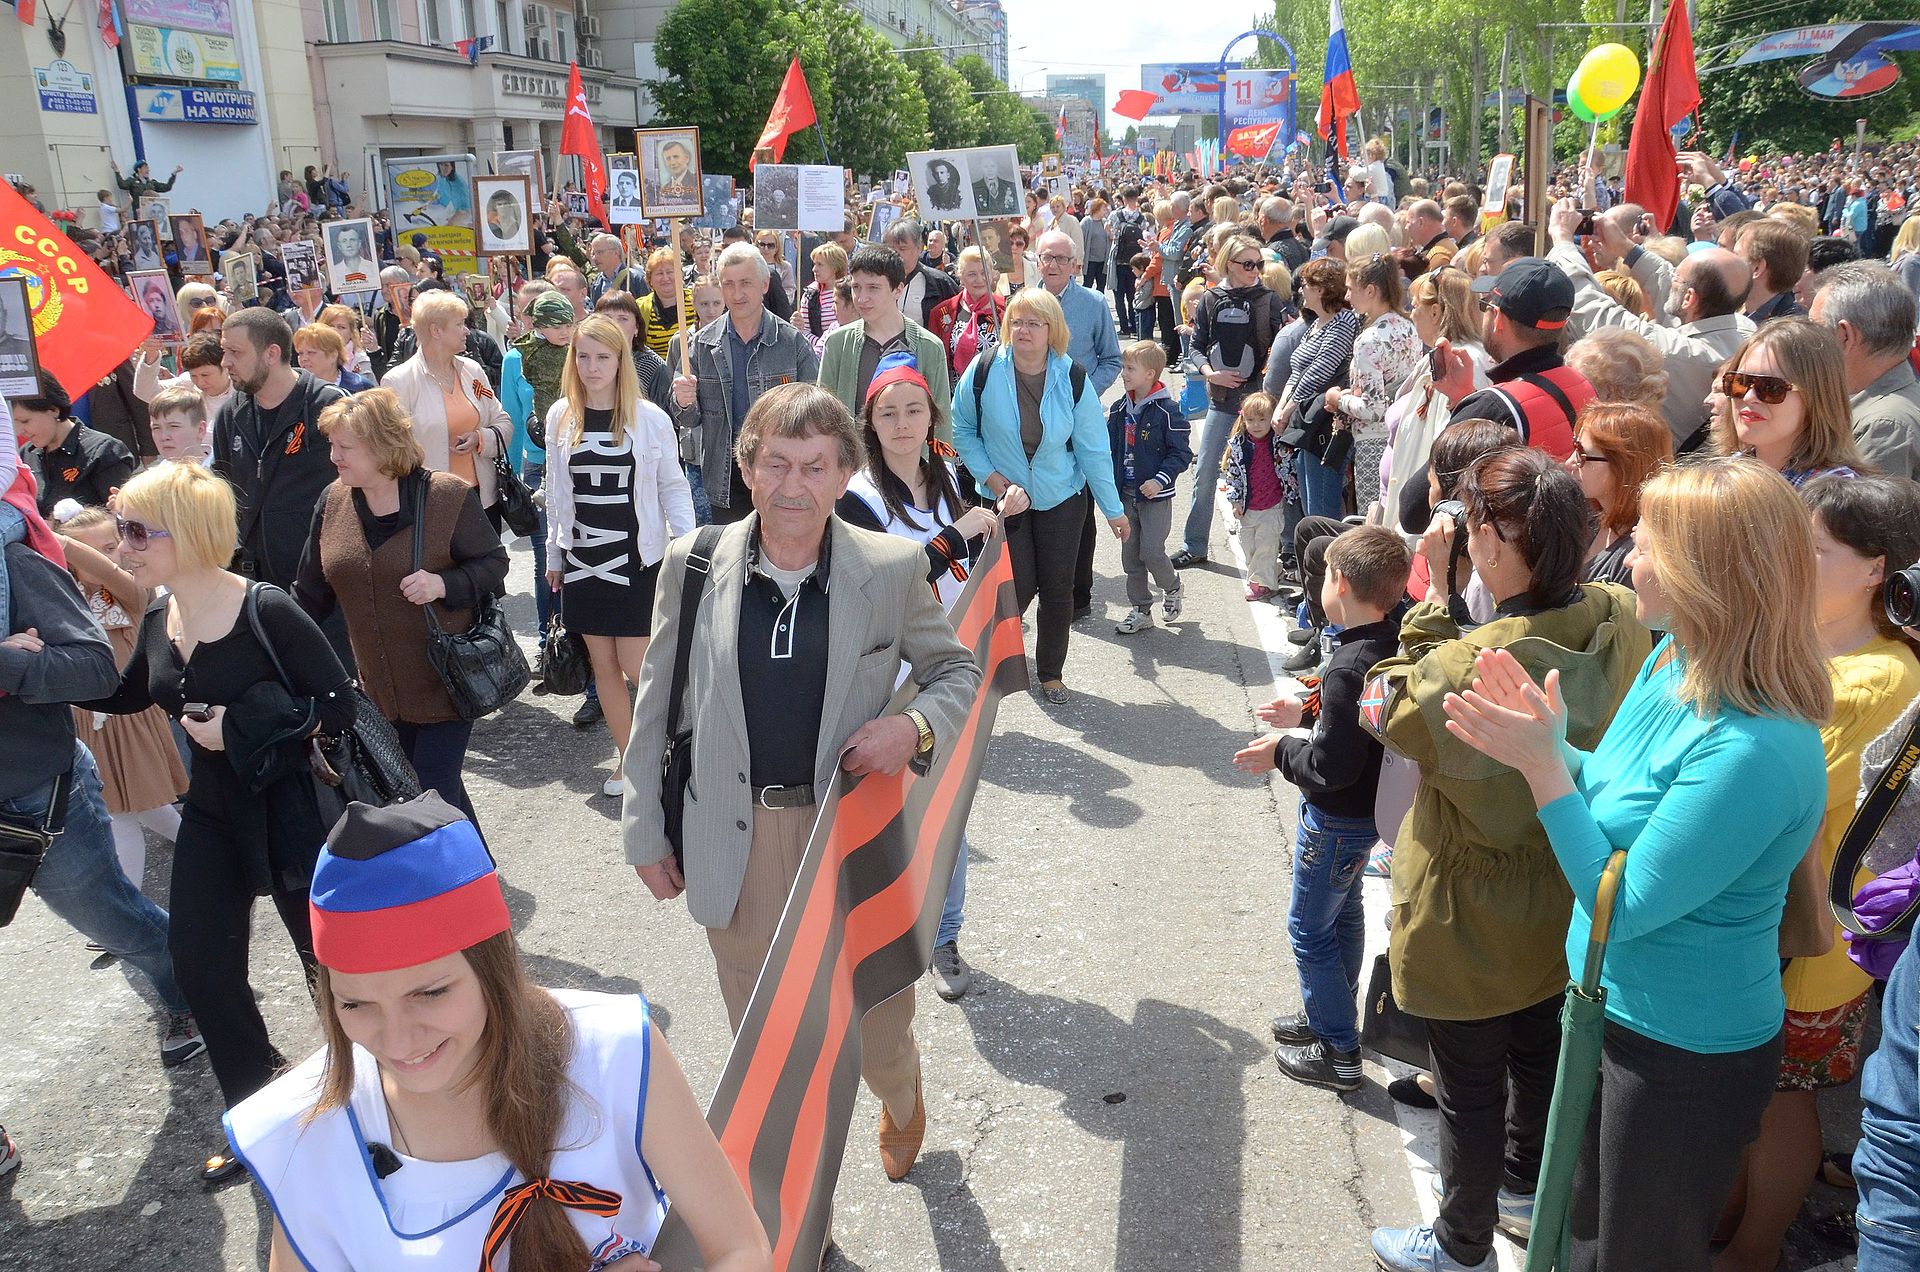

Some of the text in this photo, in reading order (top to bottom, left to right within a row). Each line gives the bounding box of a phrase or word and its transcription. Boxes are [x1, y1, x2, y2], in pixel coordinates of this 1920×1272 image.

[1797, 28, 1835, 41] 11 МАЯ
[502, 73, 559, 96] CRYSTAL
[1231, 79, 1252, 99] 11
[192, 90, 252, 105] СМОТРИТЕ
[186, 105, 210, 118] НА
[1247, 108, 1268, 118] ДЕНЬ
[14, 225, 89, 294] СССР
[563, 431, 634, 586] RELAX
